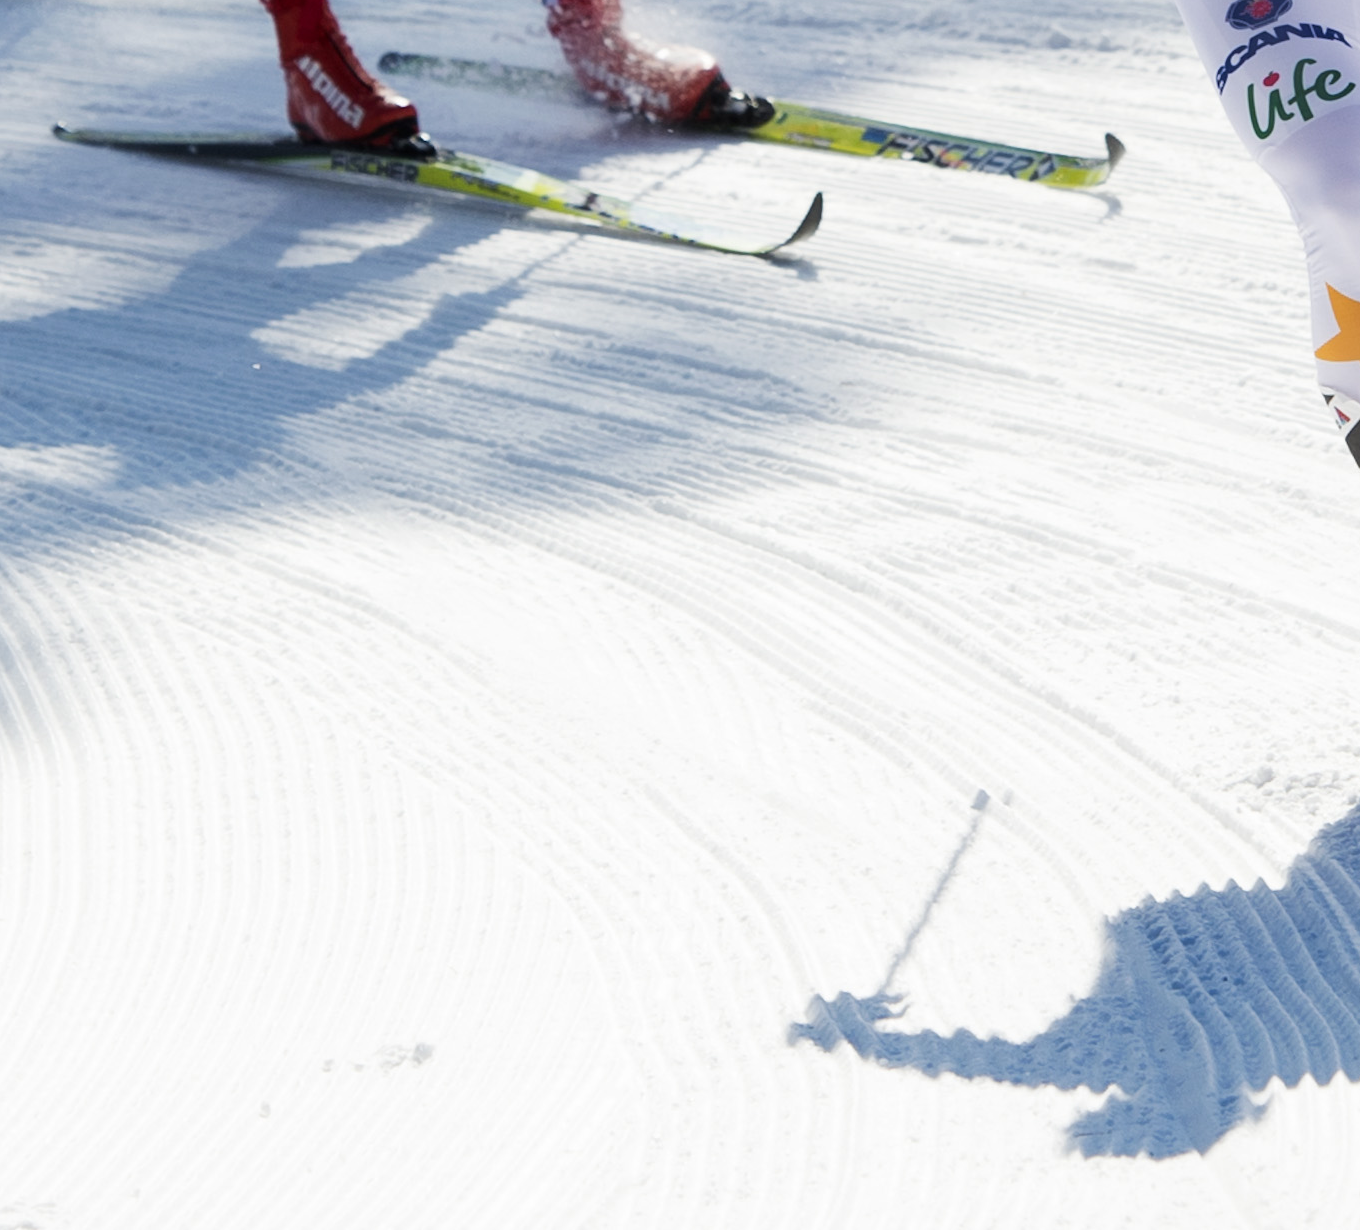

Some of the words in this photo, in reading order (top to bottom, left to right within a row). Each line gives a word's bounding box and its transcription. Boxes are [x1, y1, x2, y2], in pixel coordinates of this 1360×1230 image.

[295, 55, 365, 129] alpina
[1216, 23, 1353, 95] SCANIA
[875, 130, 1036, 179] FISCHER
